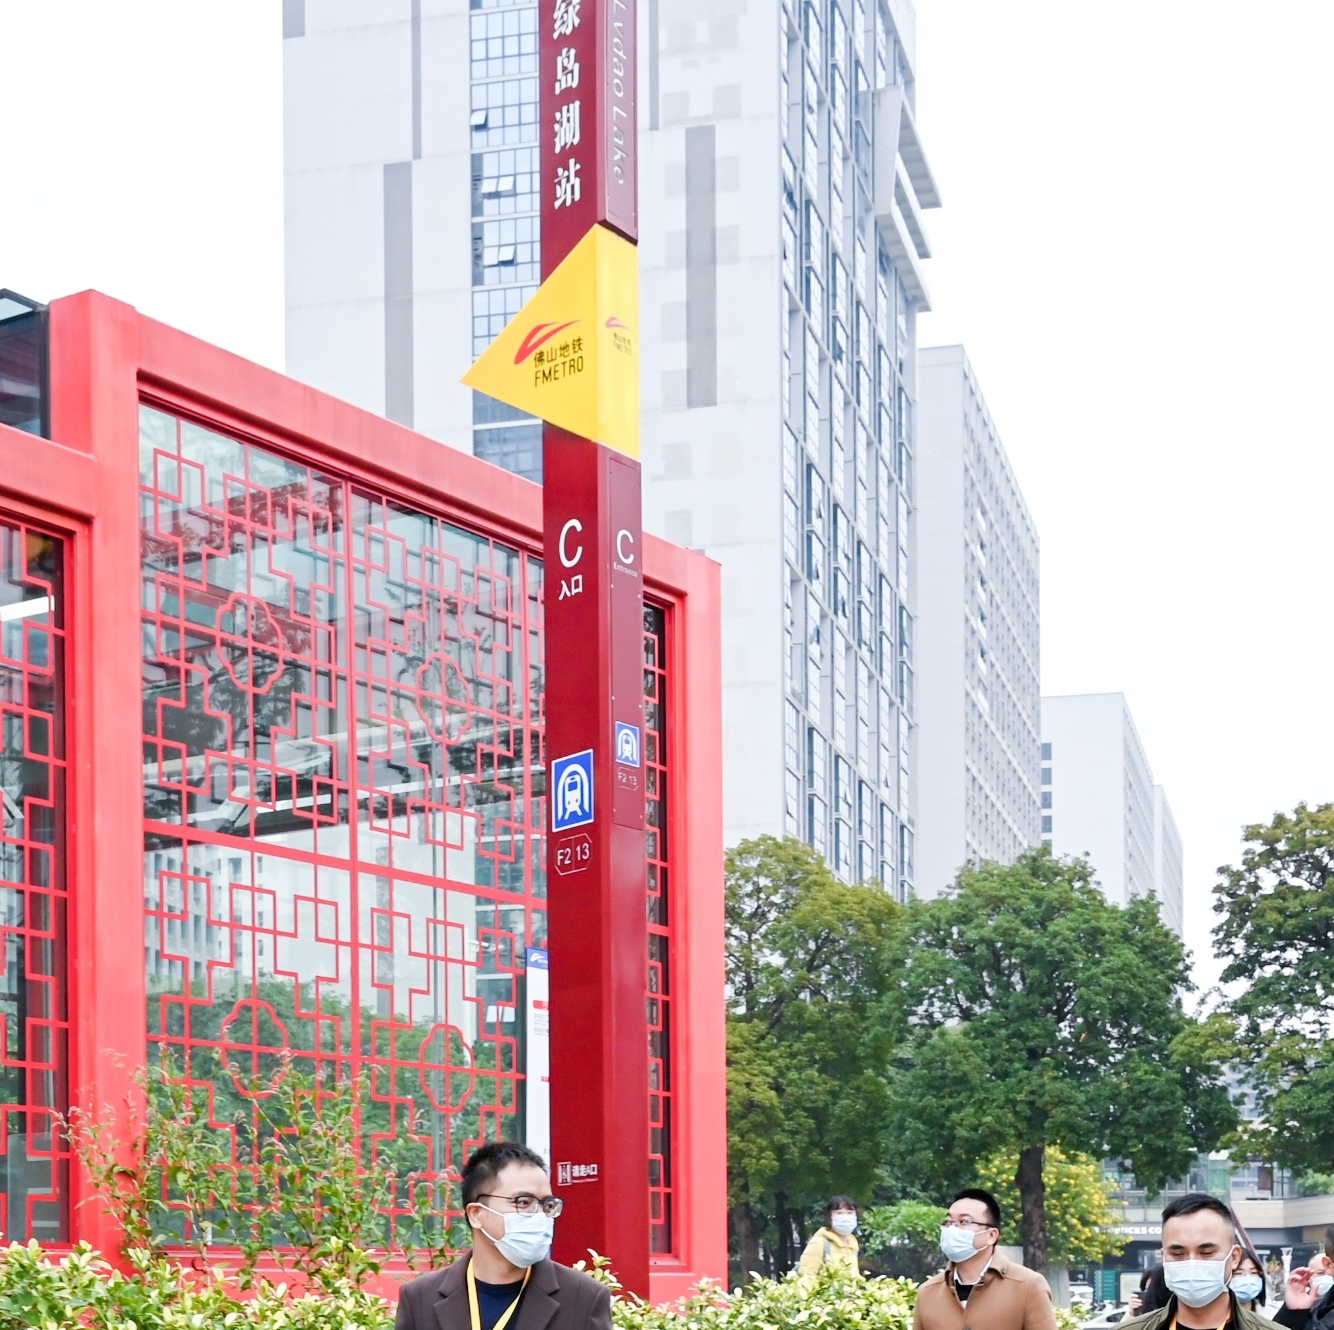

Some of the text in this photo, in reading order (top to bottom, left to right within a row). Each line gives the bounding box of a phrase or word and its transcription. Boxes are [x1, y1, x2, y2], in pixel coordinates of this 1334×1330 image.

[553, 0, 581, 210] 绿岛湖站
[613, 0, 627, 185] Lvdao Lake
[533, 337, 584, 368] 佛山地铁
[534, 355, 584, 387] FMETRO
[559, 518, 583, 568] C
[616, 529, 635, 565] C
[558, 574, 583, 601] 入口
[557, 843, 590, 865] F2 13
